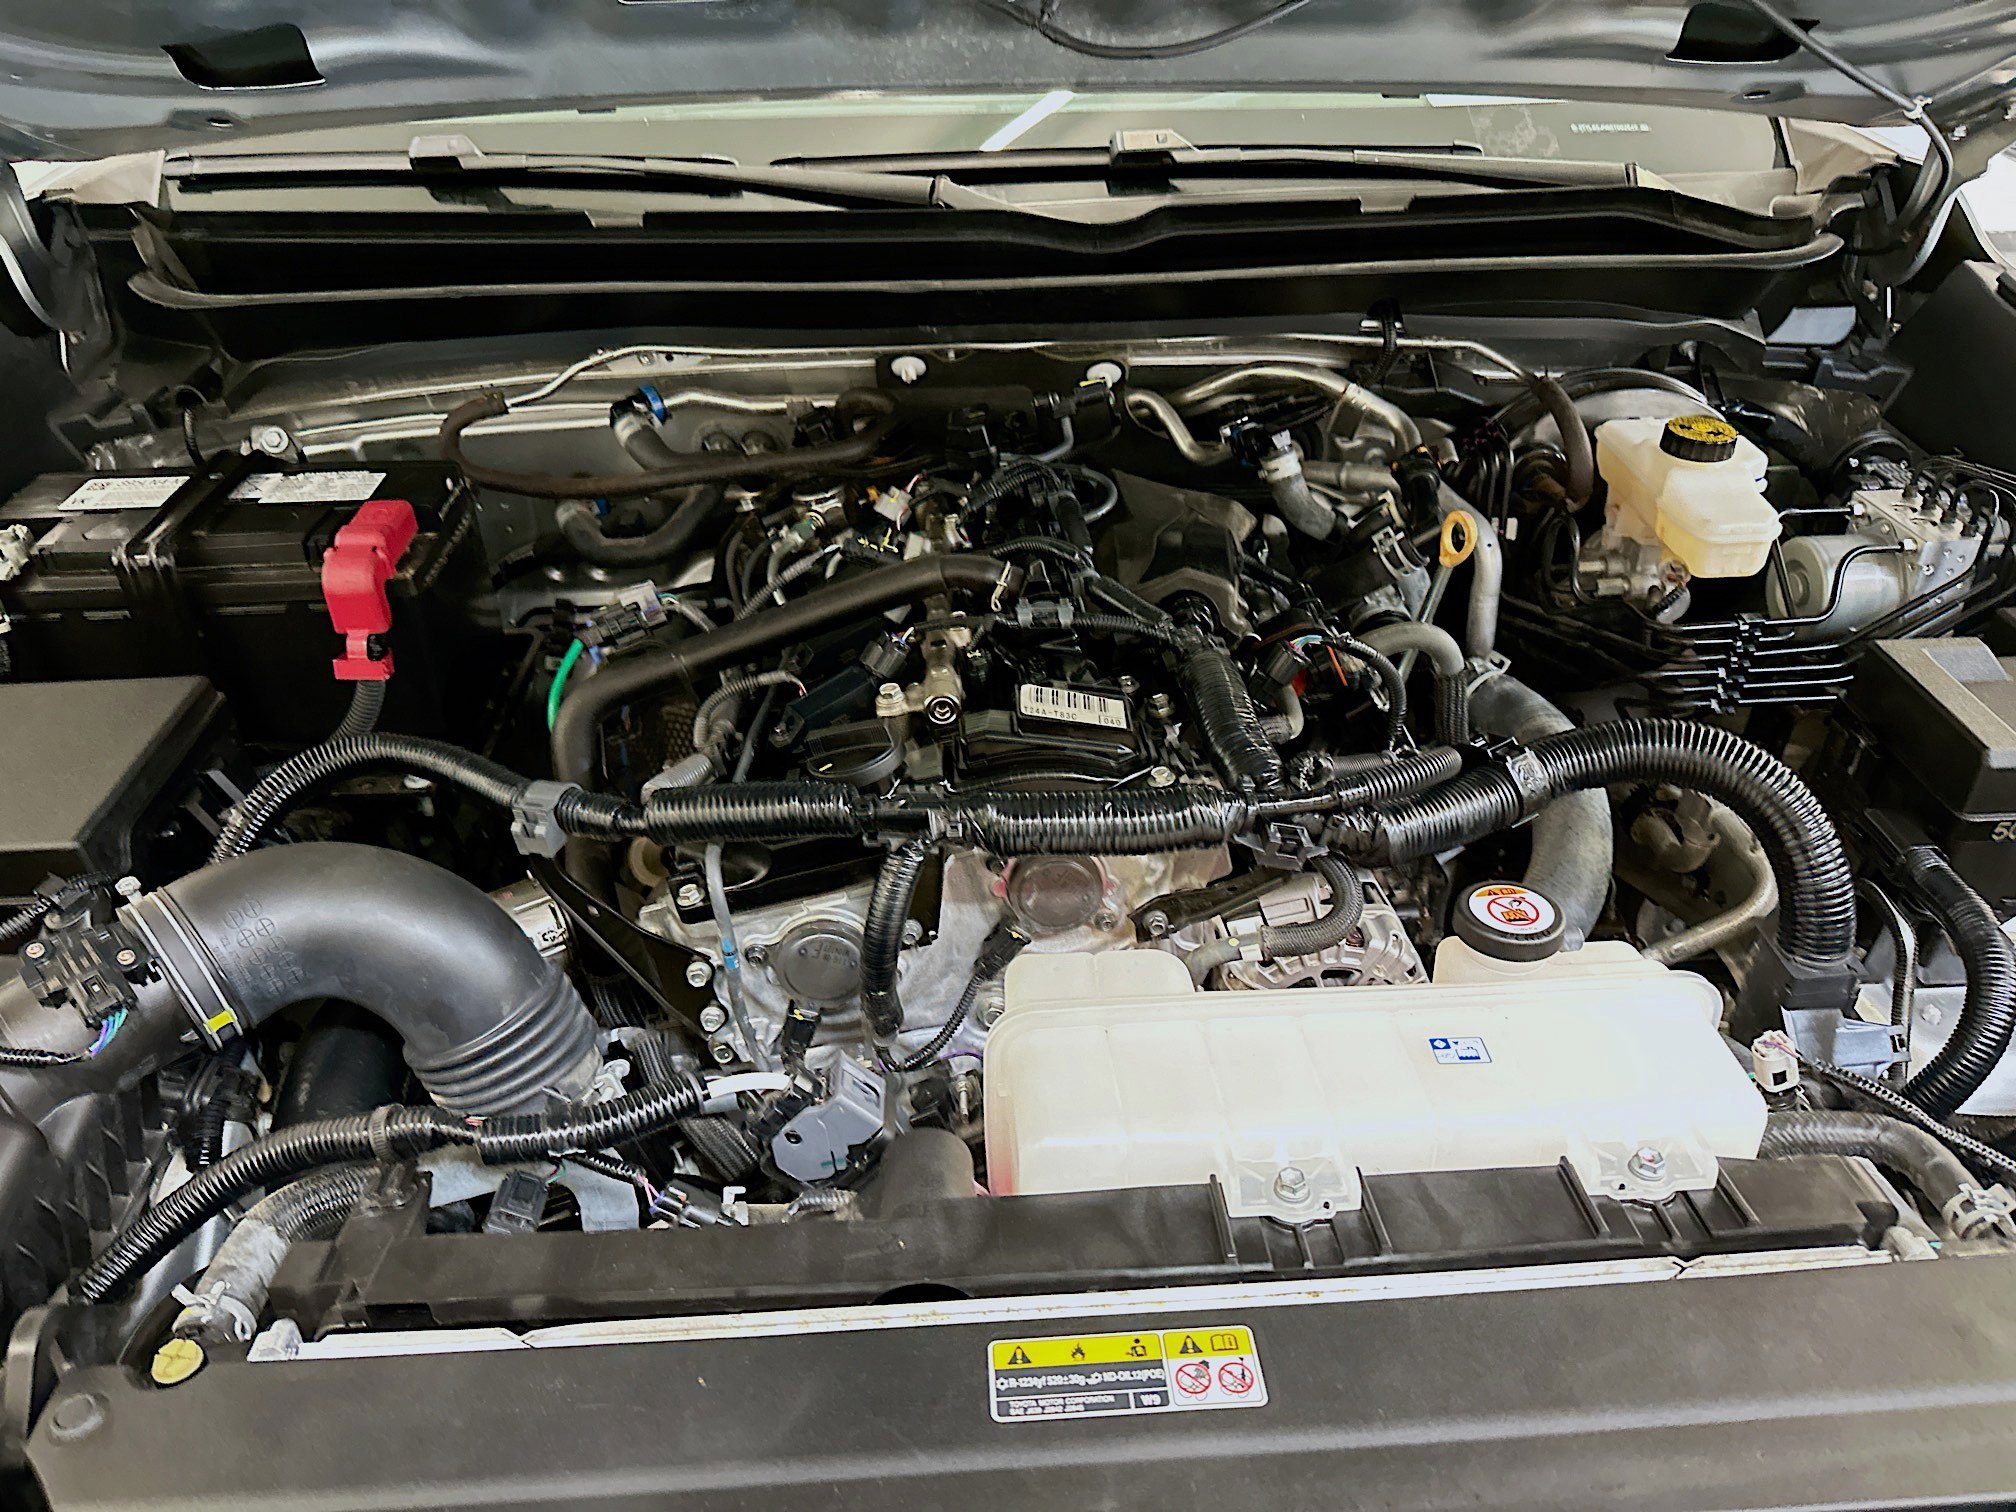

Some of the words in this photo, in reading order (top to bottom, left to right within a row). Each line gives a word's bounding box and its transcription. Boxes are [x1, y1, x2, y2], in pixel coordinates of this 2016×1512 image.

[1008, 1399, 1038, 1408] TOYOTA
[1038, 1397, 1065, 1406] MOTOR
[1064, 1394, 1115, 1405] CORPORATION
[1140, 1393, 1162, 1406] W9
